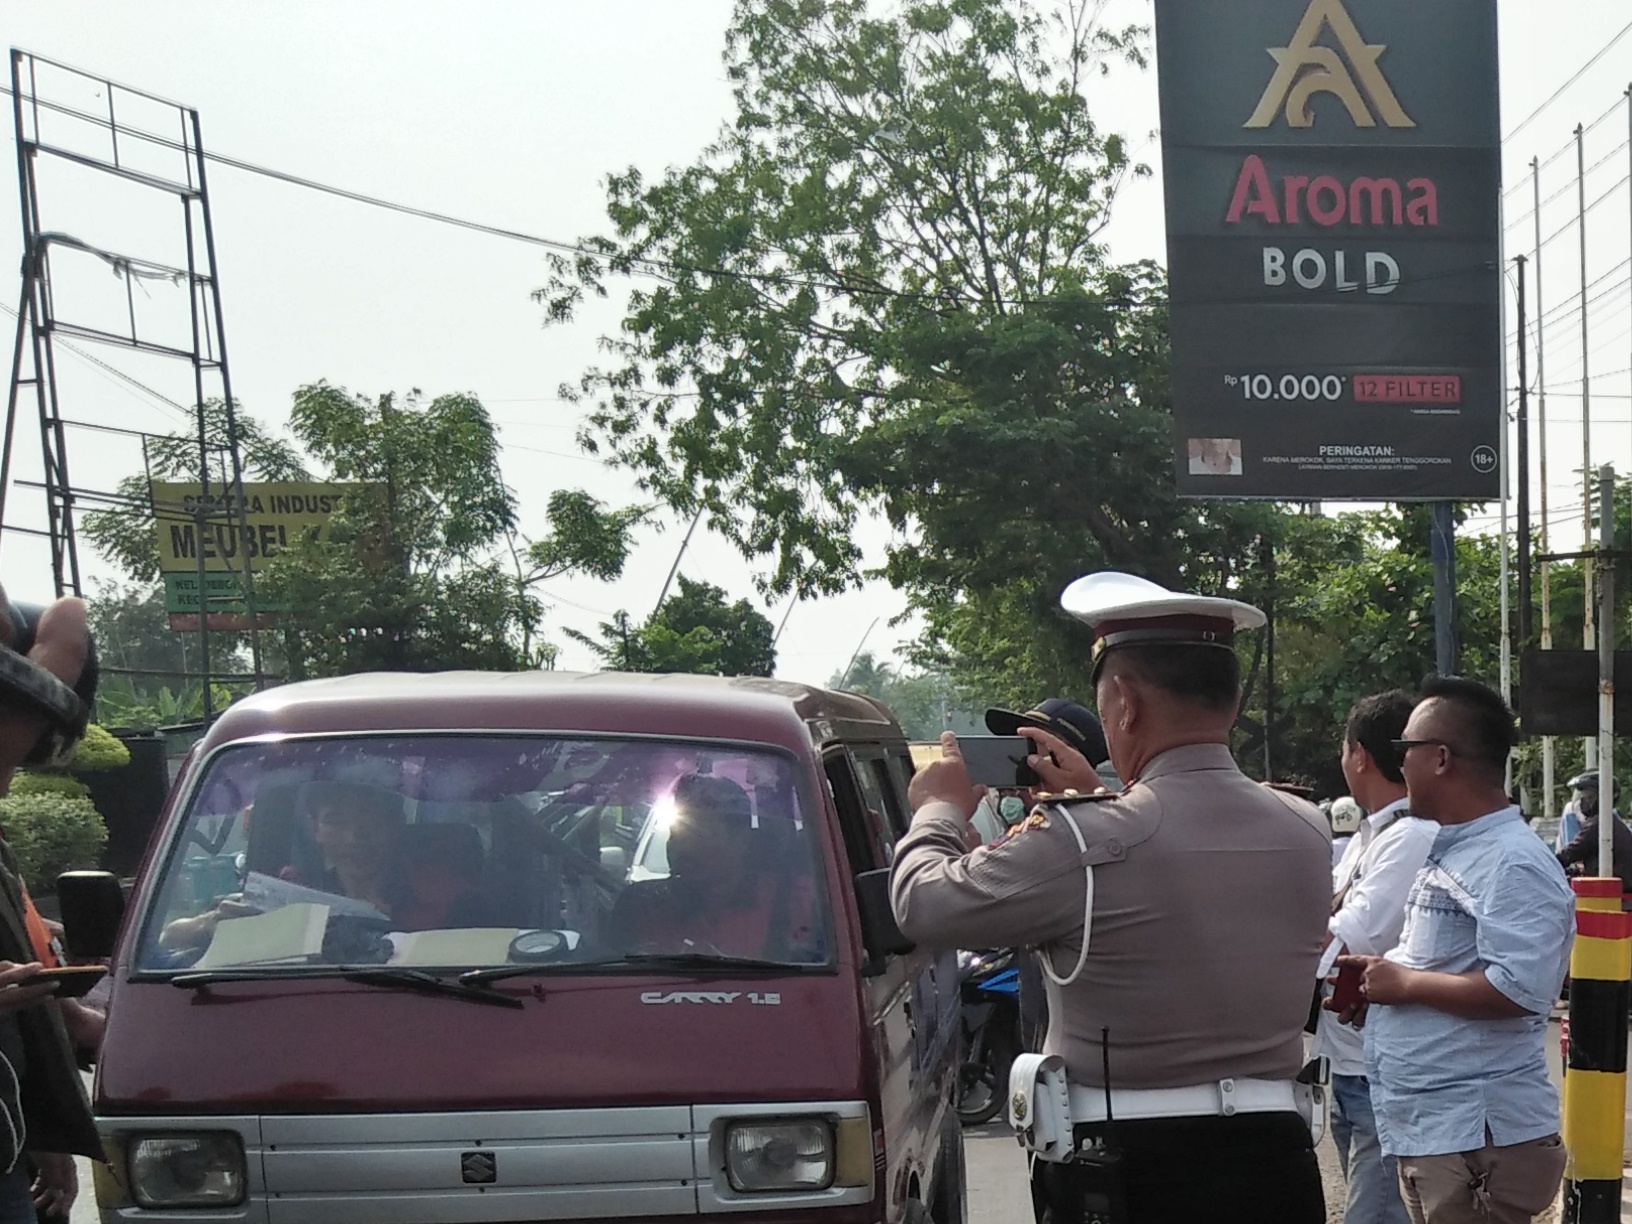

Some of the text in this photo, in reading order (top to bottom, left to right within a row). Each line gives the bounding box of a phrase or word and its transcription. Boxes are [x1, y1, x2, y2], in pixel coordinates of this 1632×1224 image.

[1225, 154, 1438, 226] Aroma
[1262, 246, 1401, 295] BOLD
[1224, 374, 1238, 387] Rp
[1358, 381, 1378, 398] 12
[1385, 380, 1457, 398] FILTER
[1319, 445, 1395, 457] PERINGATAN:
[1263, 456, 1290, 464] KARENA
[1474, 453, 1494, 465] 18+
[640, 991, 742, 1004] CARRY
